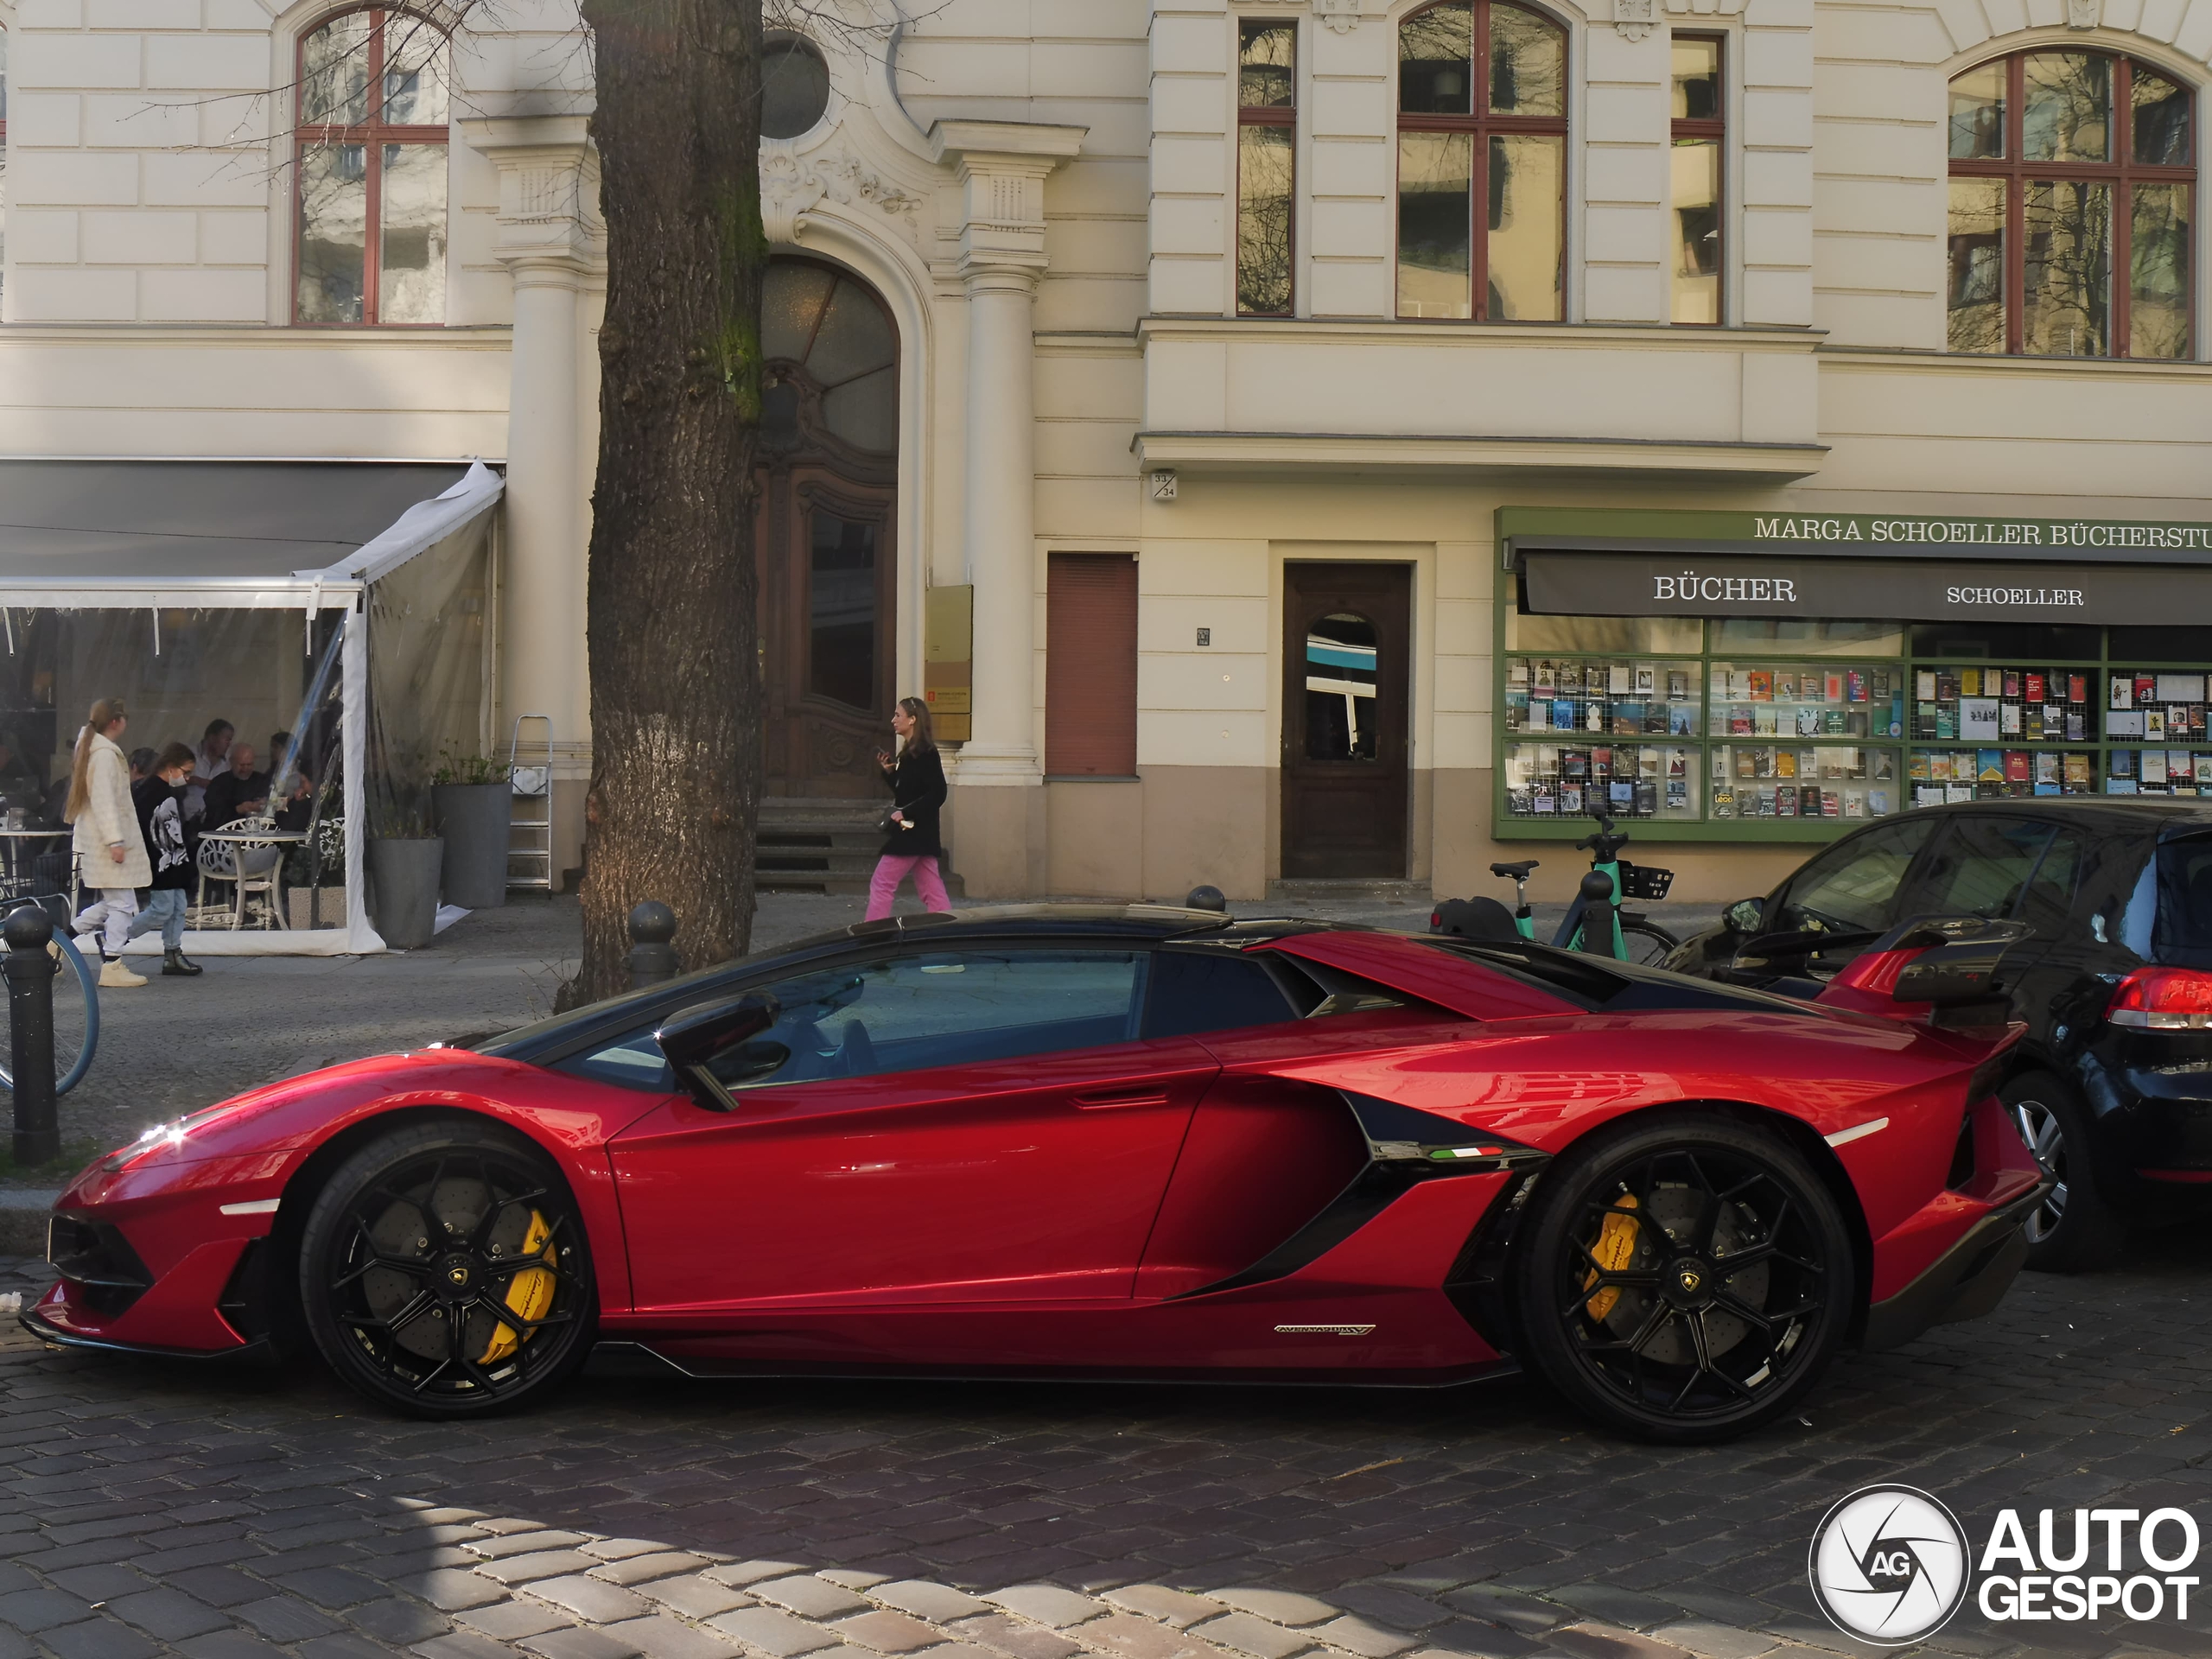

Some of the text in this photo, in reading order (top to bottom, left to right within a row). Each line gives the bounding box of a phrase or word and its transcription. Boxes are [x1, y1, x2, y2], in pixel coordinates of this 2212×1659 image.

[1754, 518, 1864, 540] MARGA
[1872, 520, 2042, 545] SCHOELLER
[1654, 570, 1796, 602] BÜCHER
[1947, 587, 2084, 606] SCHOELLER
